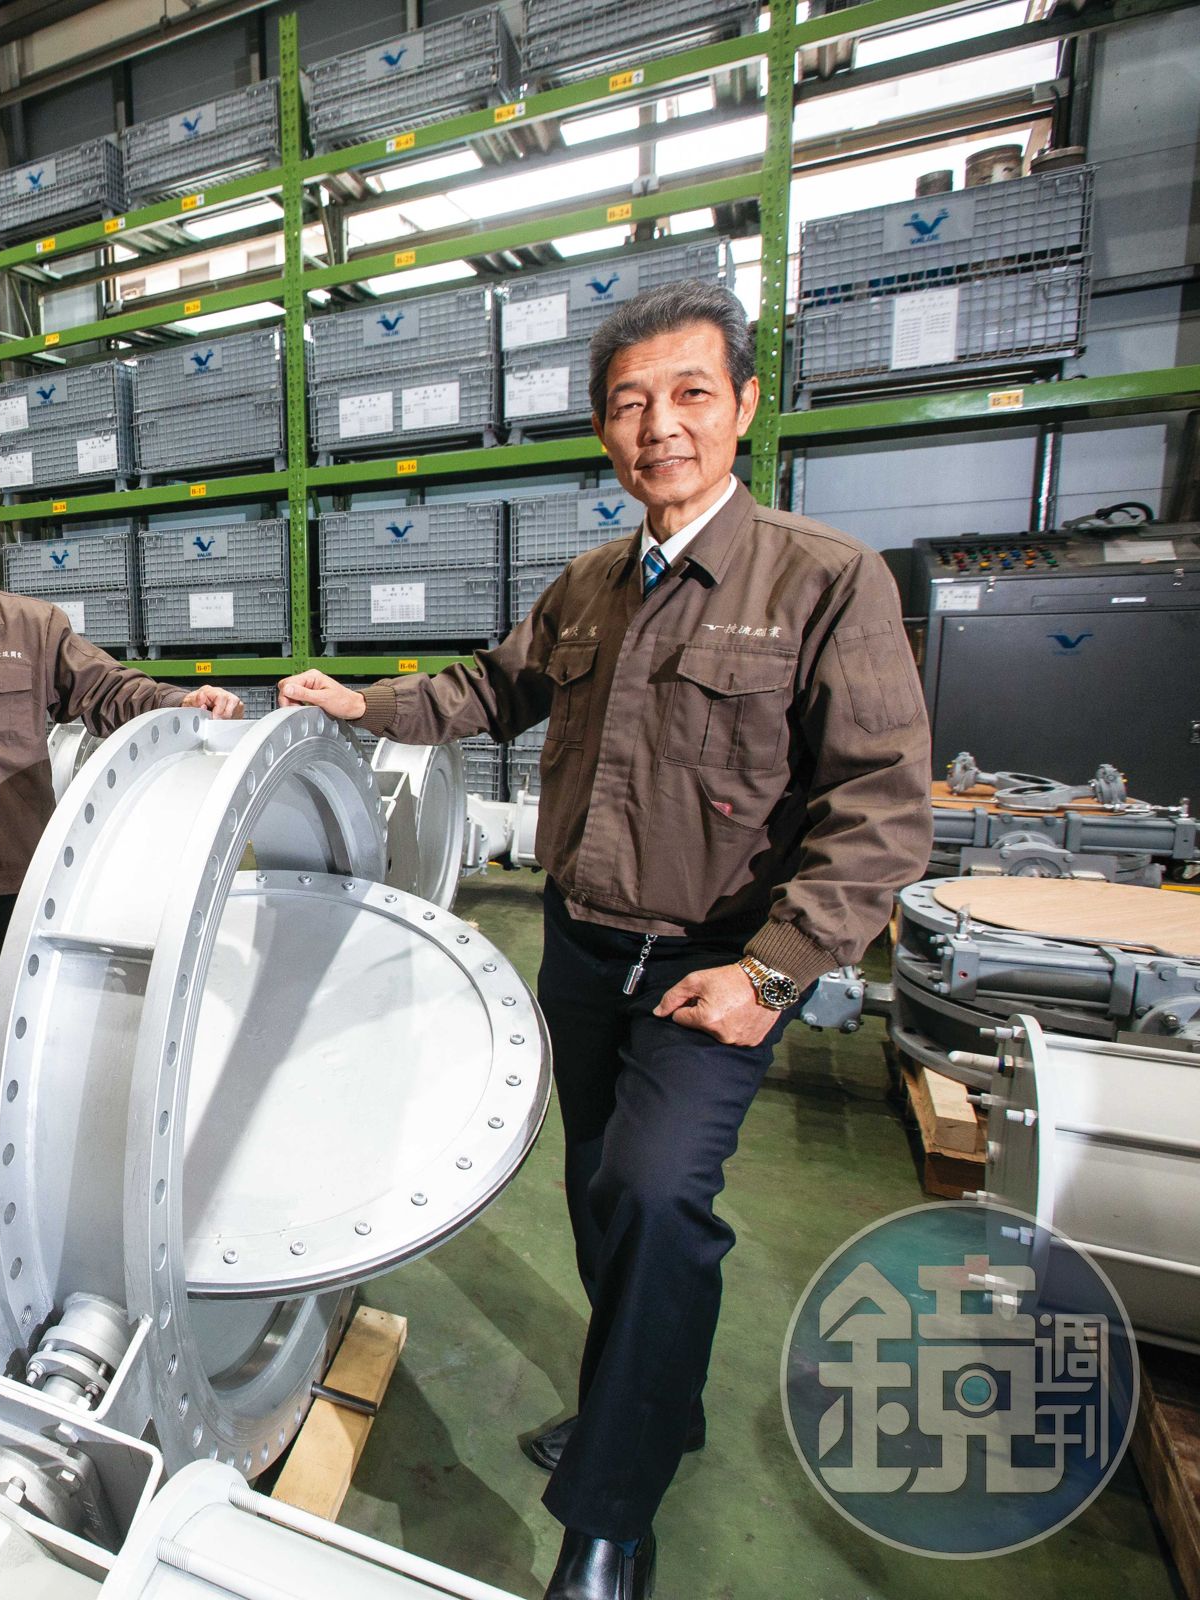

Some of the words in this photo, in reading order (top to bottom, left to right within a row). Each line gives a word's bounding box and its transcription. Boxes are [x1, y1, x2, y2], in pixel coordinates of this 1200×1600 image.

[399, 462, 416, 473] B-16
[191, 486, 205, 496] B-17
[197, 663, 211, 672] B-07
[399, 662, 417, 670] B-06
